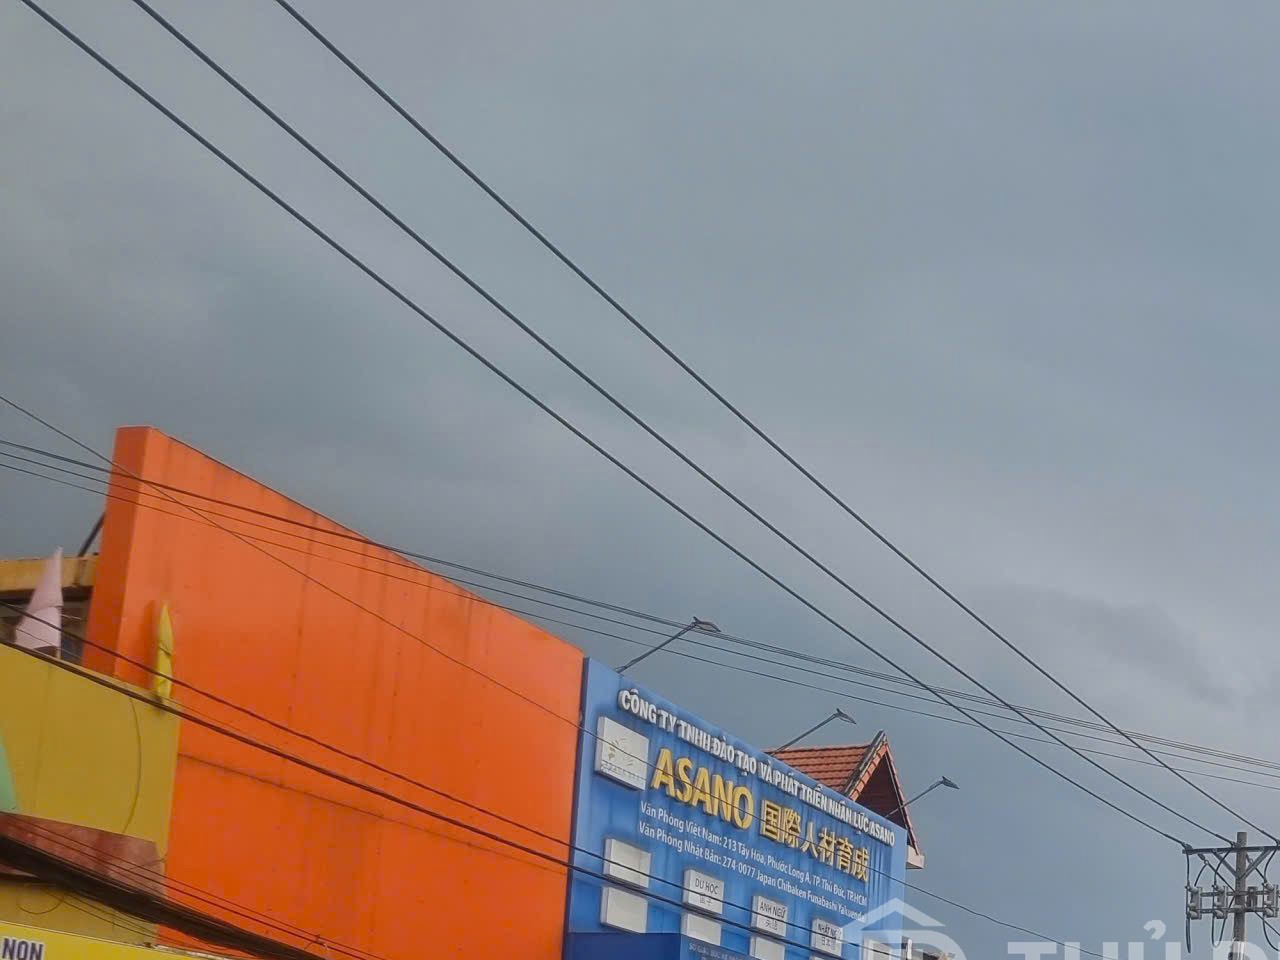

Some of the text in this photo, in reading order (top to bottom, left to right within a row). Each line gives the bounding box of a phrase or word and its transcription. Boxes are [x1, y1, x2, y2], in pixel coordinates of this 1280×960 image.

[619, 688, 895, 847] CÔNG TY TNHH ĐÀO TẠO VÀ PHÁT TRIỂN NHÂN LỰC ASANO
[650, 748, 754, 830] ASANO
[639, 821, 655, 838] Văn
[656, 827, 683, 852] Phòng
[684, 839, 703, 860] Nhật
[757, 870, 776, 886] Japan
[640, 800, 656, 818] Văn
[658, 808, 684, 833] Phòng
[685, 821, 701, 839] Việt
[723, 836, 737, 852] 213
[738, 842, 749, 859] Tây
[788, 865, 804, 882] Long
[760, 900, 772, 914] ANH
